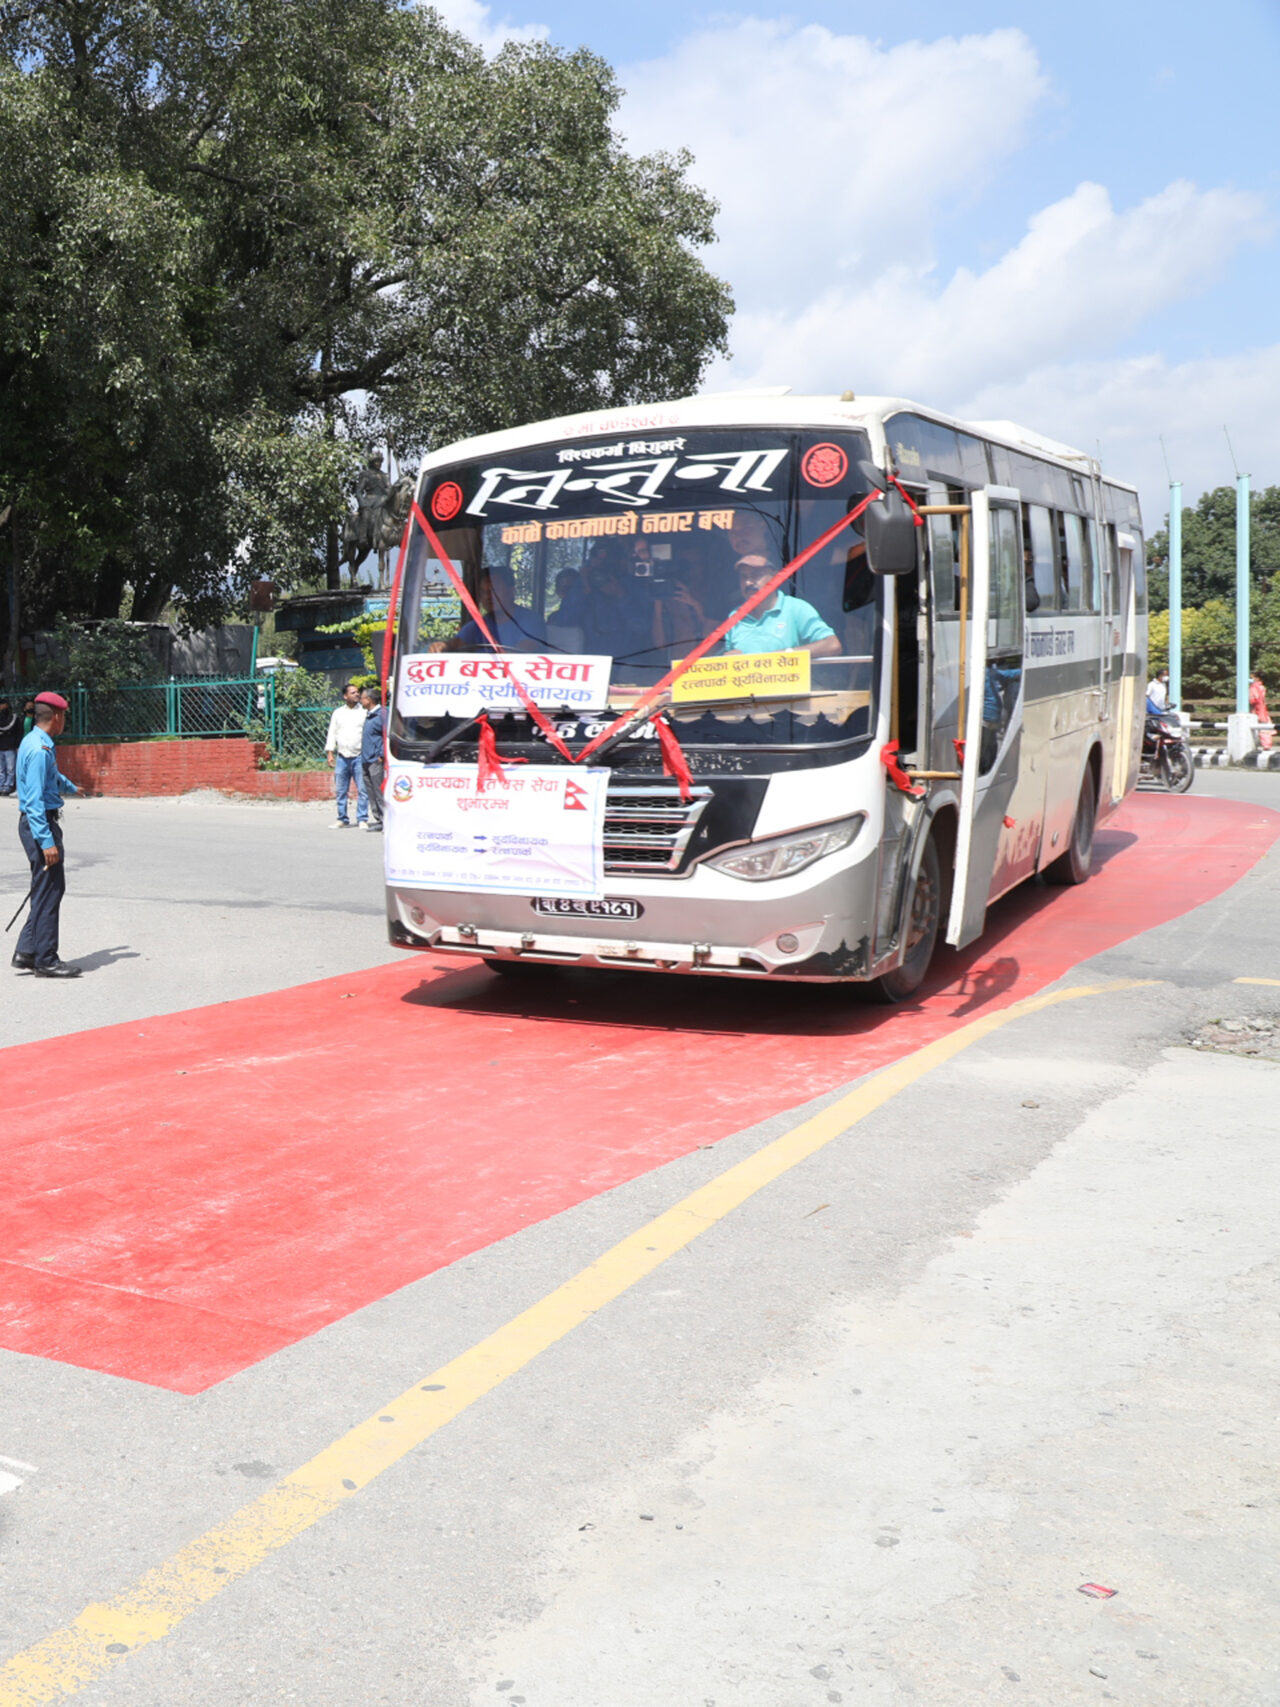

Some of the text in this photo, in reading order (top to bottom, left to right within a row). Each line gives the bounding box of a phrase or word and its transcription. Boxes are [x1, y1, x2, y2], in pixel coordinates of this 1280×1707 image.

[641, 511, 695, 534] नगर
[407, 656, 594, 683] द्रुत बस सेवा
[682, 661, 728, 674] पत्यका
[753, 658, 772, 669] बस
[776, 655, 800, 668] सेवा
[416, 776, 471, 790] उपत्यका
[531, 776, 559, 793] सेवा
